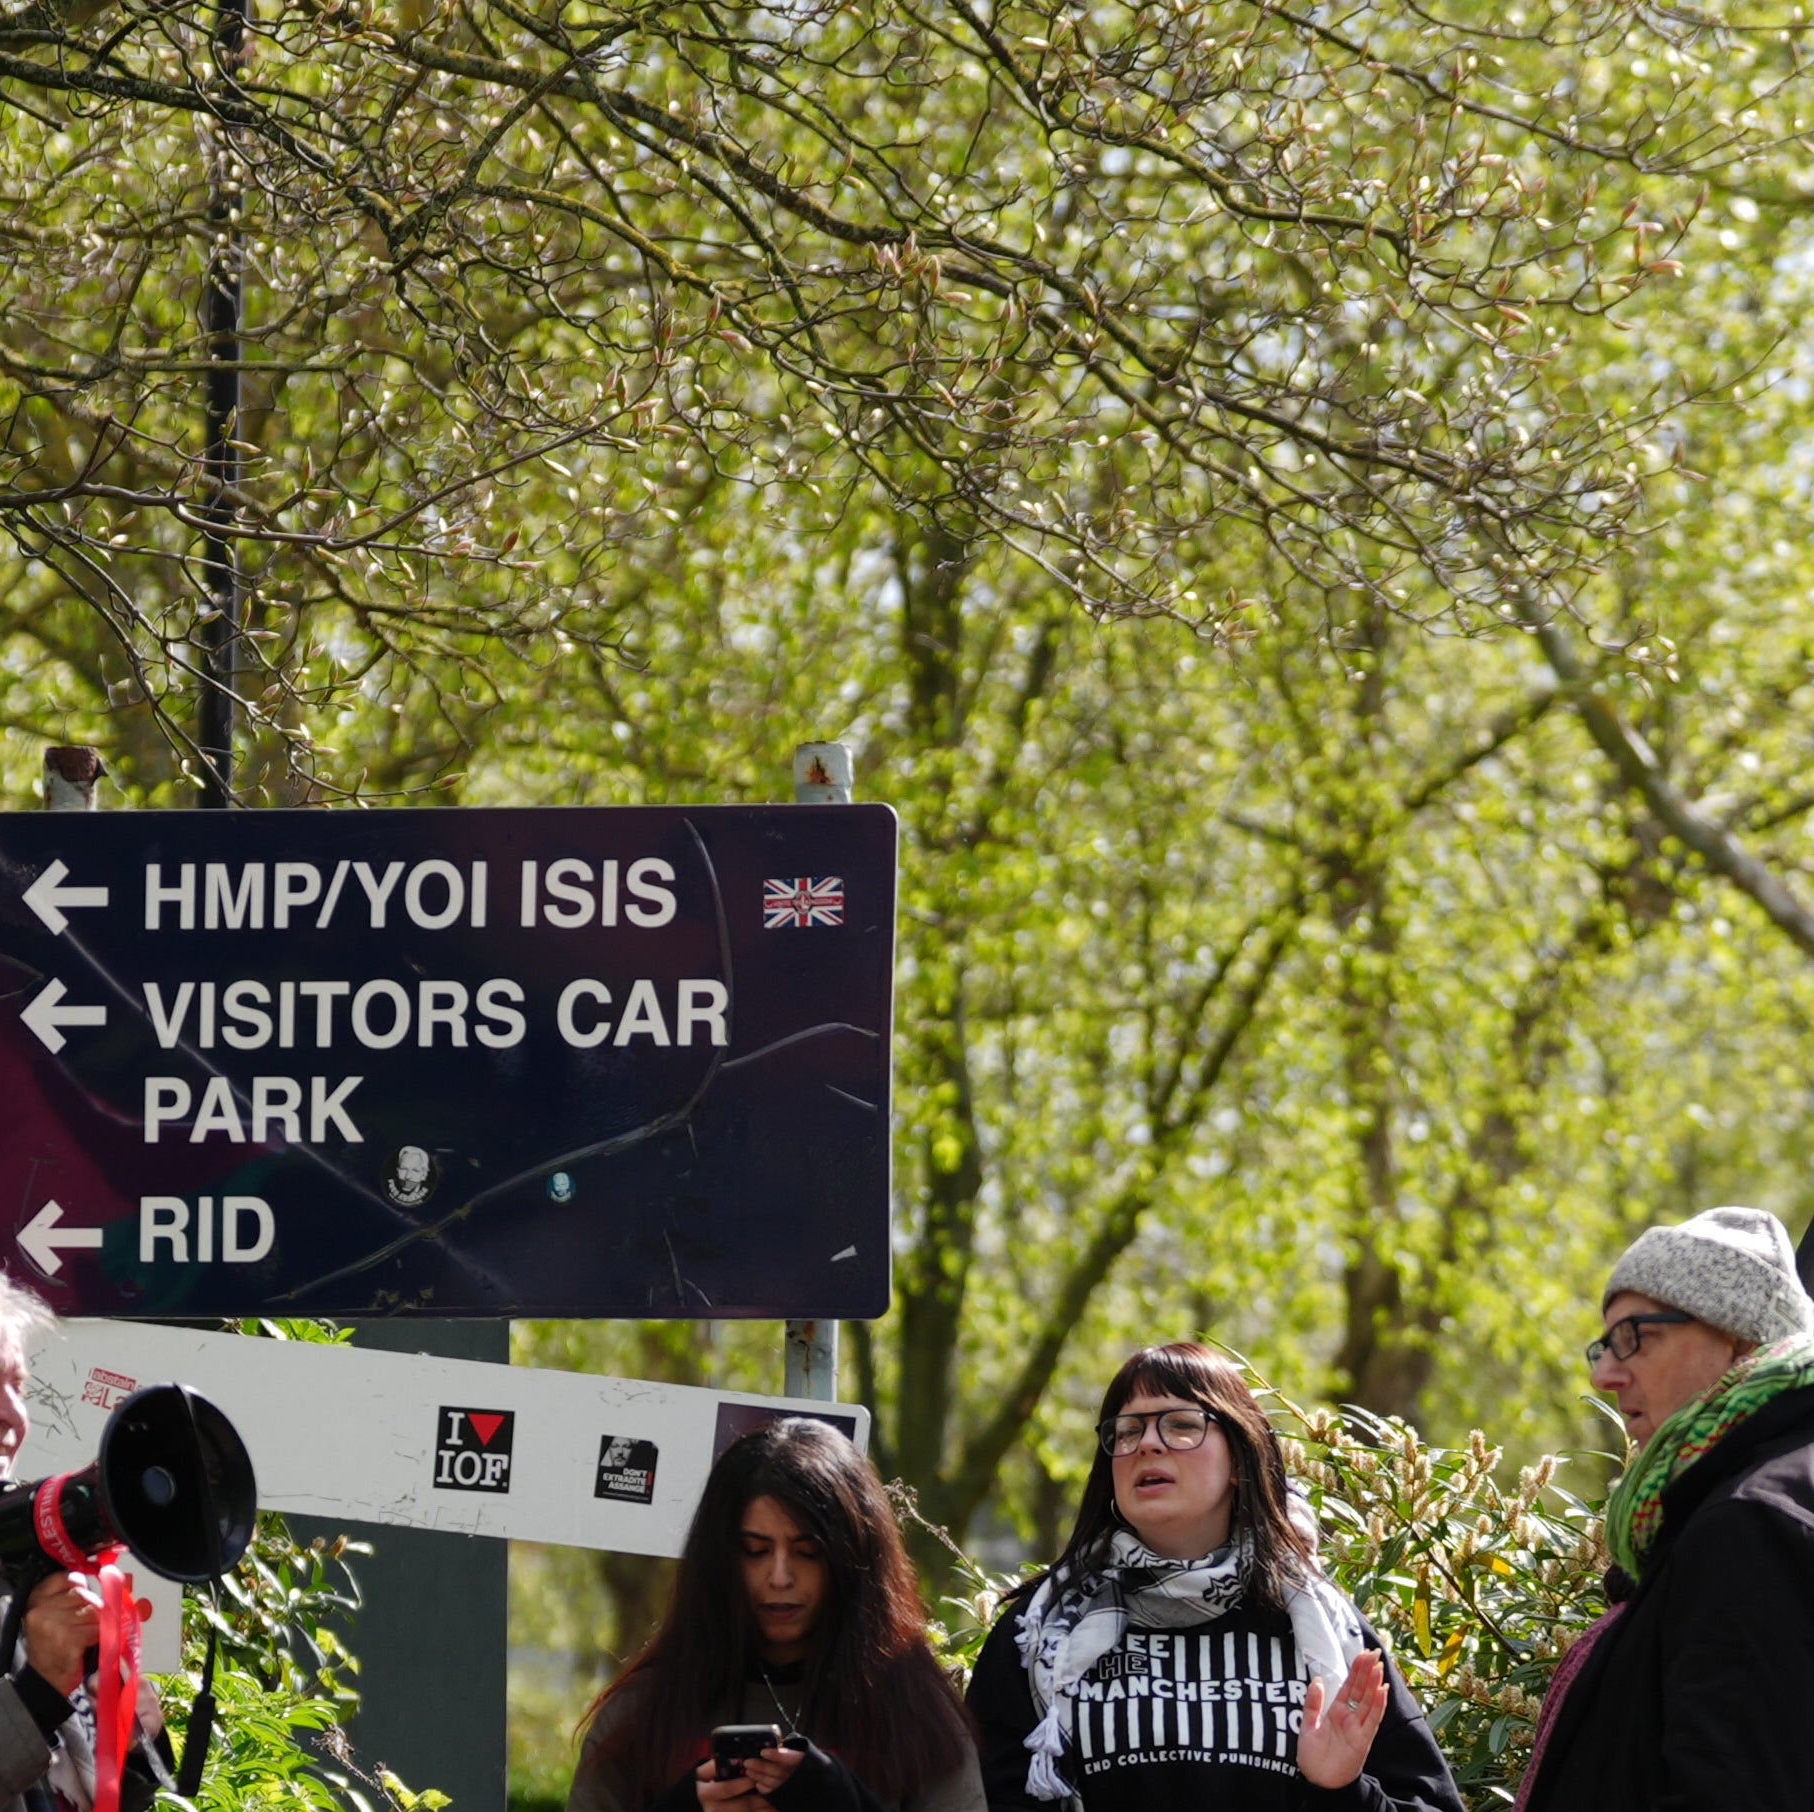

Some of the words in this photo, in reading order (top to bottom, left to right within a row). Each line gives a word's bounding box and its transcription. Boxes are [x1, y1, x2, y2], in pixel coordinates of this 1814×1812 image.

[144, 859, 487, 930] HMP/YOI
[521, 857, 678, 929] ISIS
[142, 978, 527, 1050] VISITORS
[555, 977, 730, 1048] CAR
[143, 1075, 365, 1144] PARK
[138, 1196, 276, 1263] RID
[445, 1411, 465, 1445] I
[1078, 1675, 1308, 1706] MANCHESTER
[1098, 1652, 1149, 1680] HE
[1084, 1757, 1112, 1776] END
[1117, 1749, 1212, 1767] COLLECTIVE
